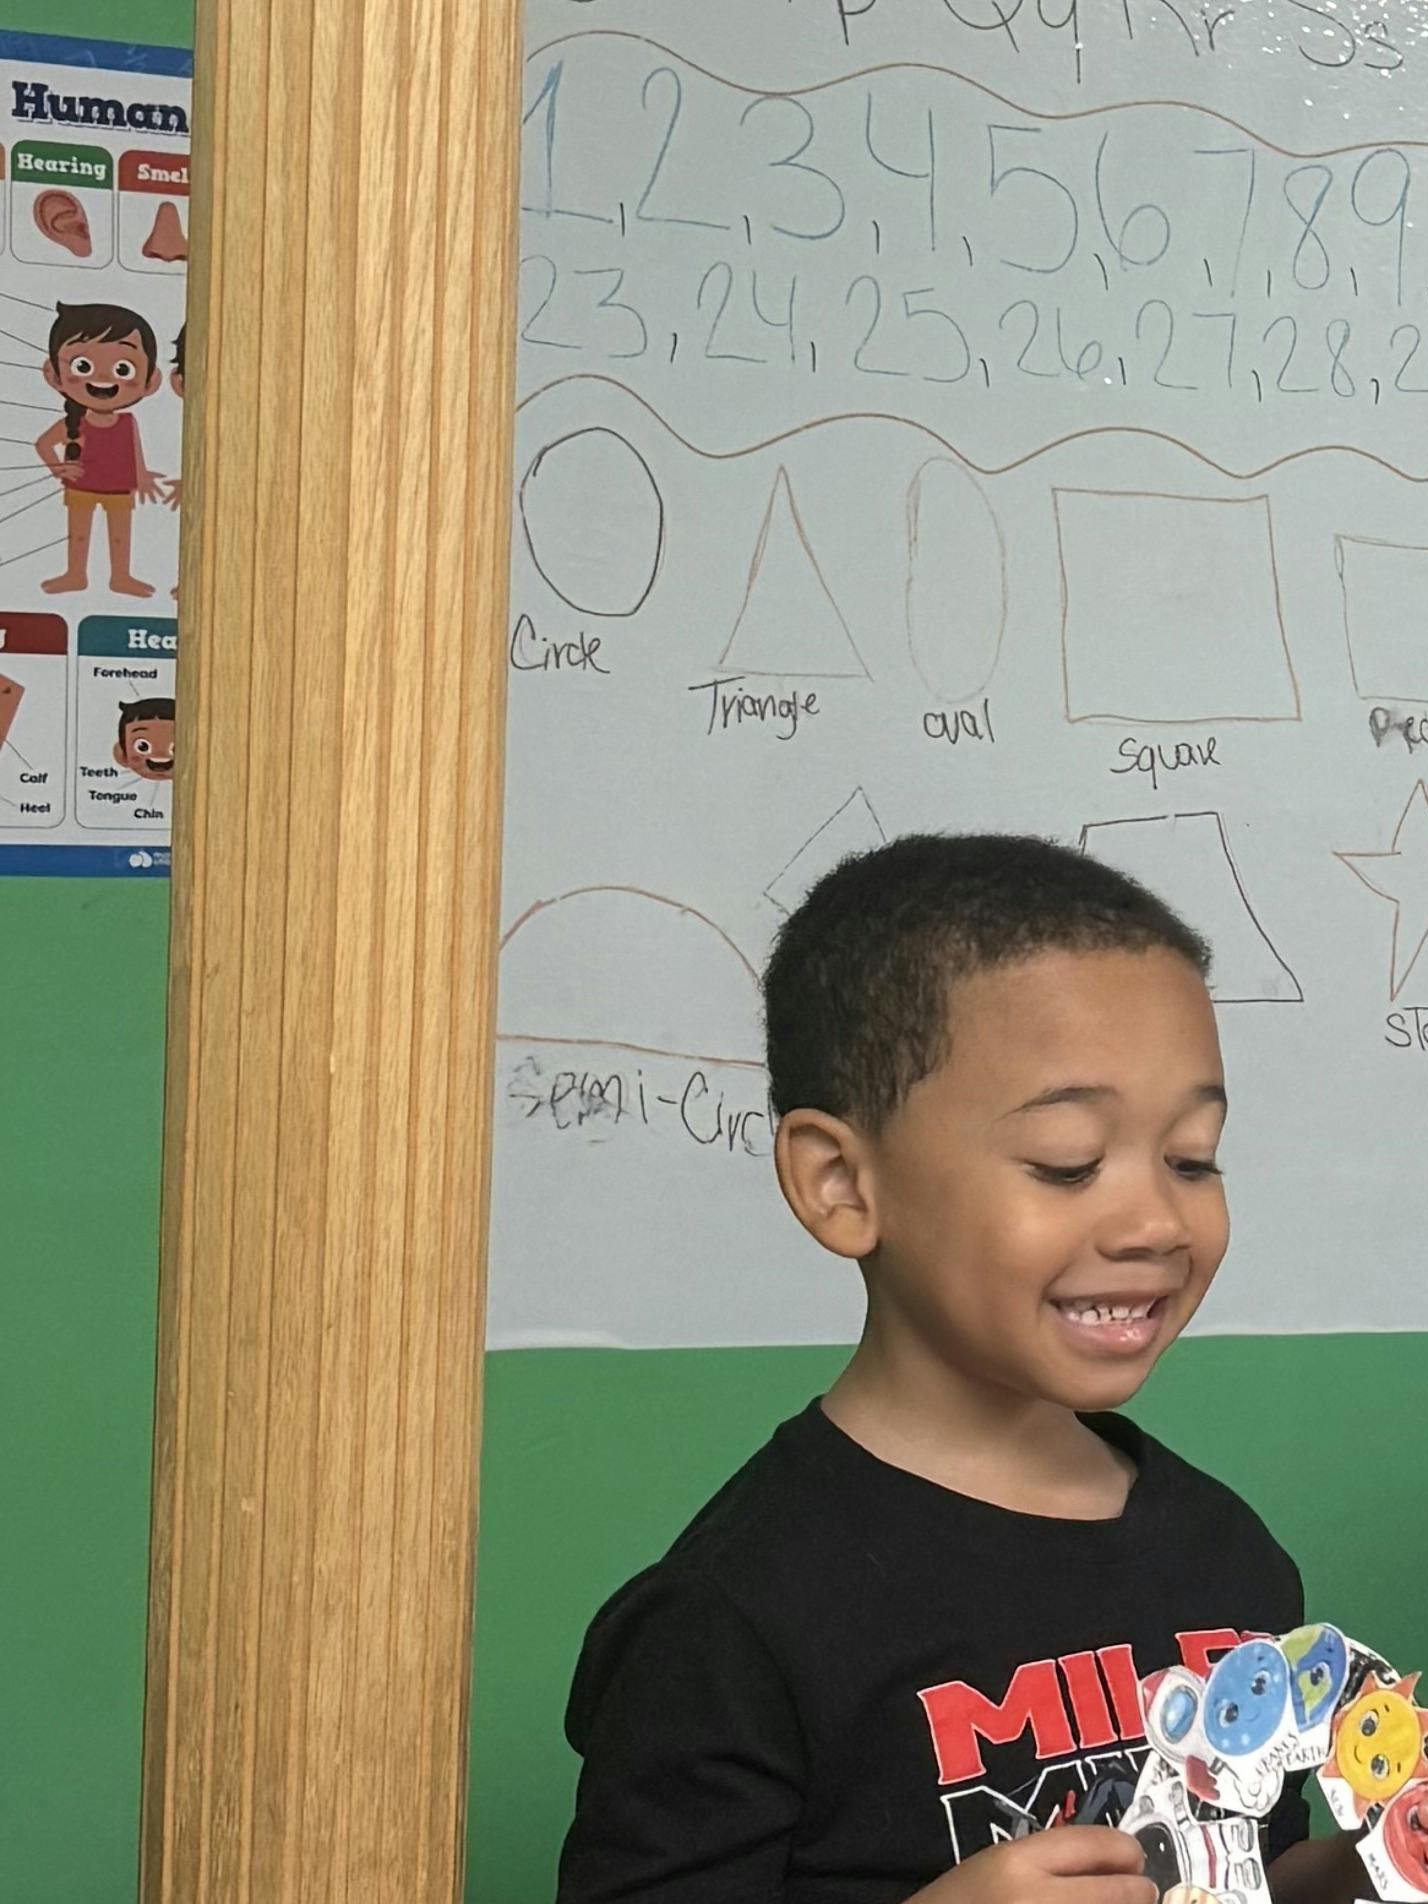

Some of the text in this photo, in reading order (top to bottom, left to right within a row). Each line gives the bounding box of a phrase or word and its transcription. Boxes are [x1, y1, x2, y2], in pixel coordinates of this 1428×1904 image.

[12, 80, 190, 134] Human
[17, 152, 107, 182] Hearing
[137, 163, 190, 184] Smel
[128, 628, 177, 650] Hea
[508, 614, 612, 676] Circle
[92, 666, 158, 680] Forehead
[686, 675, 823, 740] Triangle
[19, 772, 49, 784] Calf
[79, 766, 119, 779] Teeth
[89, 789, 138, 804] Tongue
[20, 802, 51, 814] Heel
[133, 807, 165, 820] Chin
